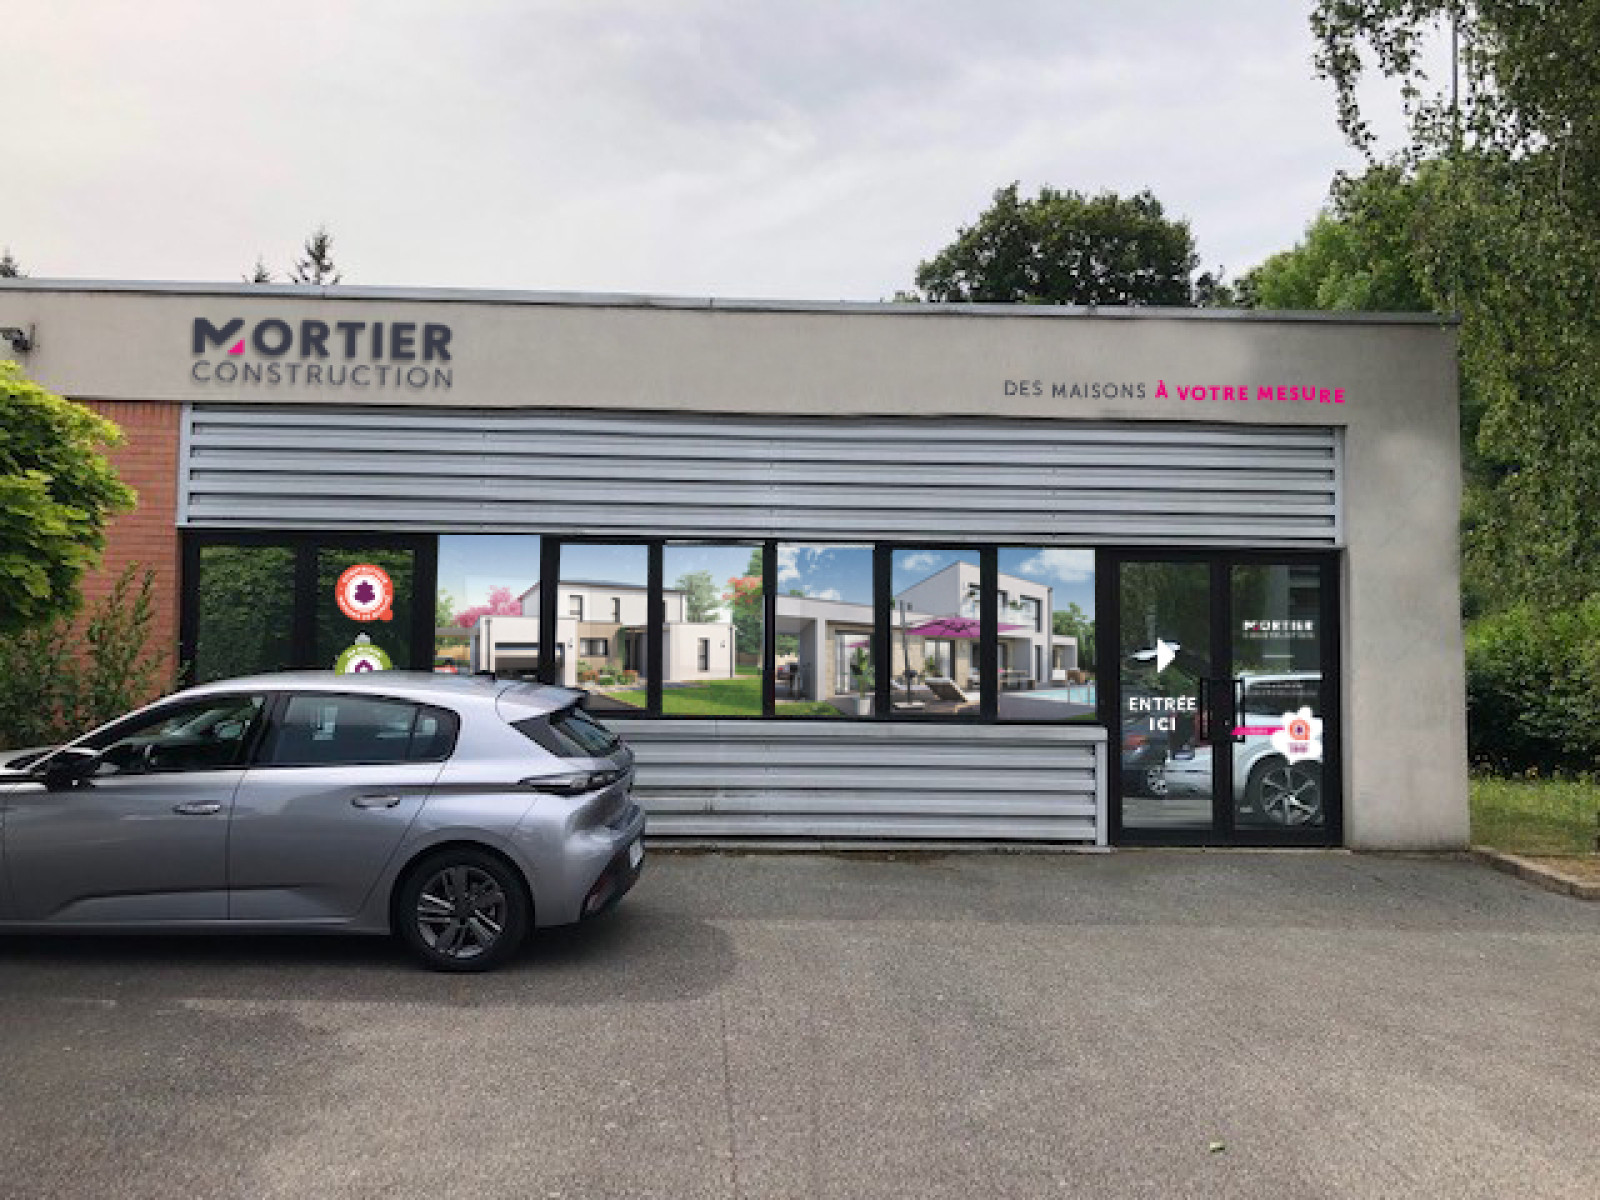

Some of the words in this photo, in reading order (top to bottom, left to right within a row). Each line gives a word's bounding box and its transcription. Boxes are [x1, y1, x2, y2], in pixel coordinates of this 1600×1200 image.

[192, 316, 453, 361] MORTIER
[191, 359, 453, 388] CONSTRUCTION
[1004, 379, 1043, 397] DES
[1051, 382, 1146, 400] MAISONS
[1155, 379, 1169, 400] À
[1176, 384, 1249, 401] VOTRE
[1256, 384, 1347, 404] MESURE
[1129, 694, 1197, 712] ENTRÉE
[1149, 716, 1176, 731] ICI
